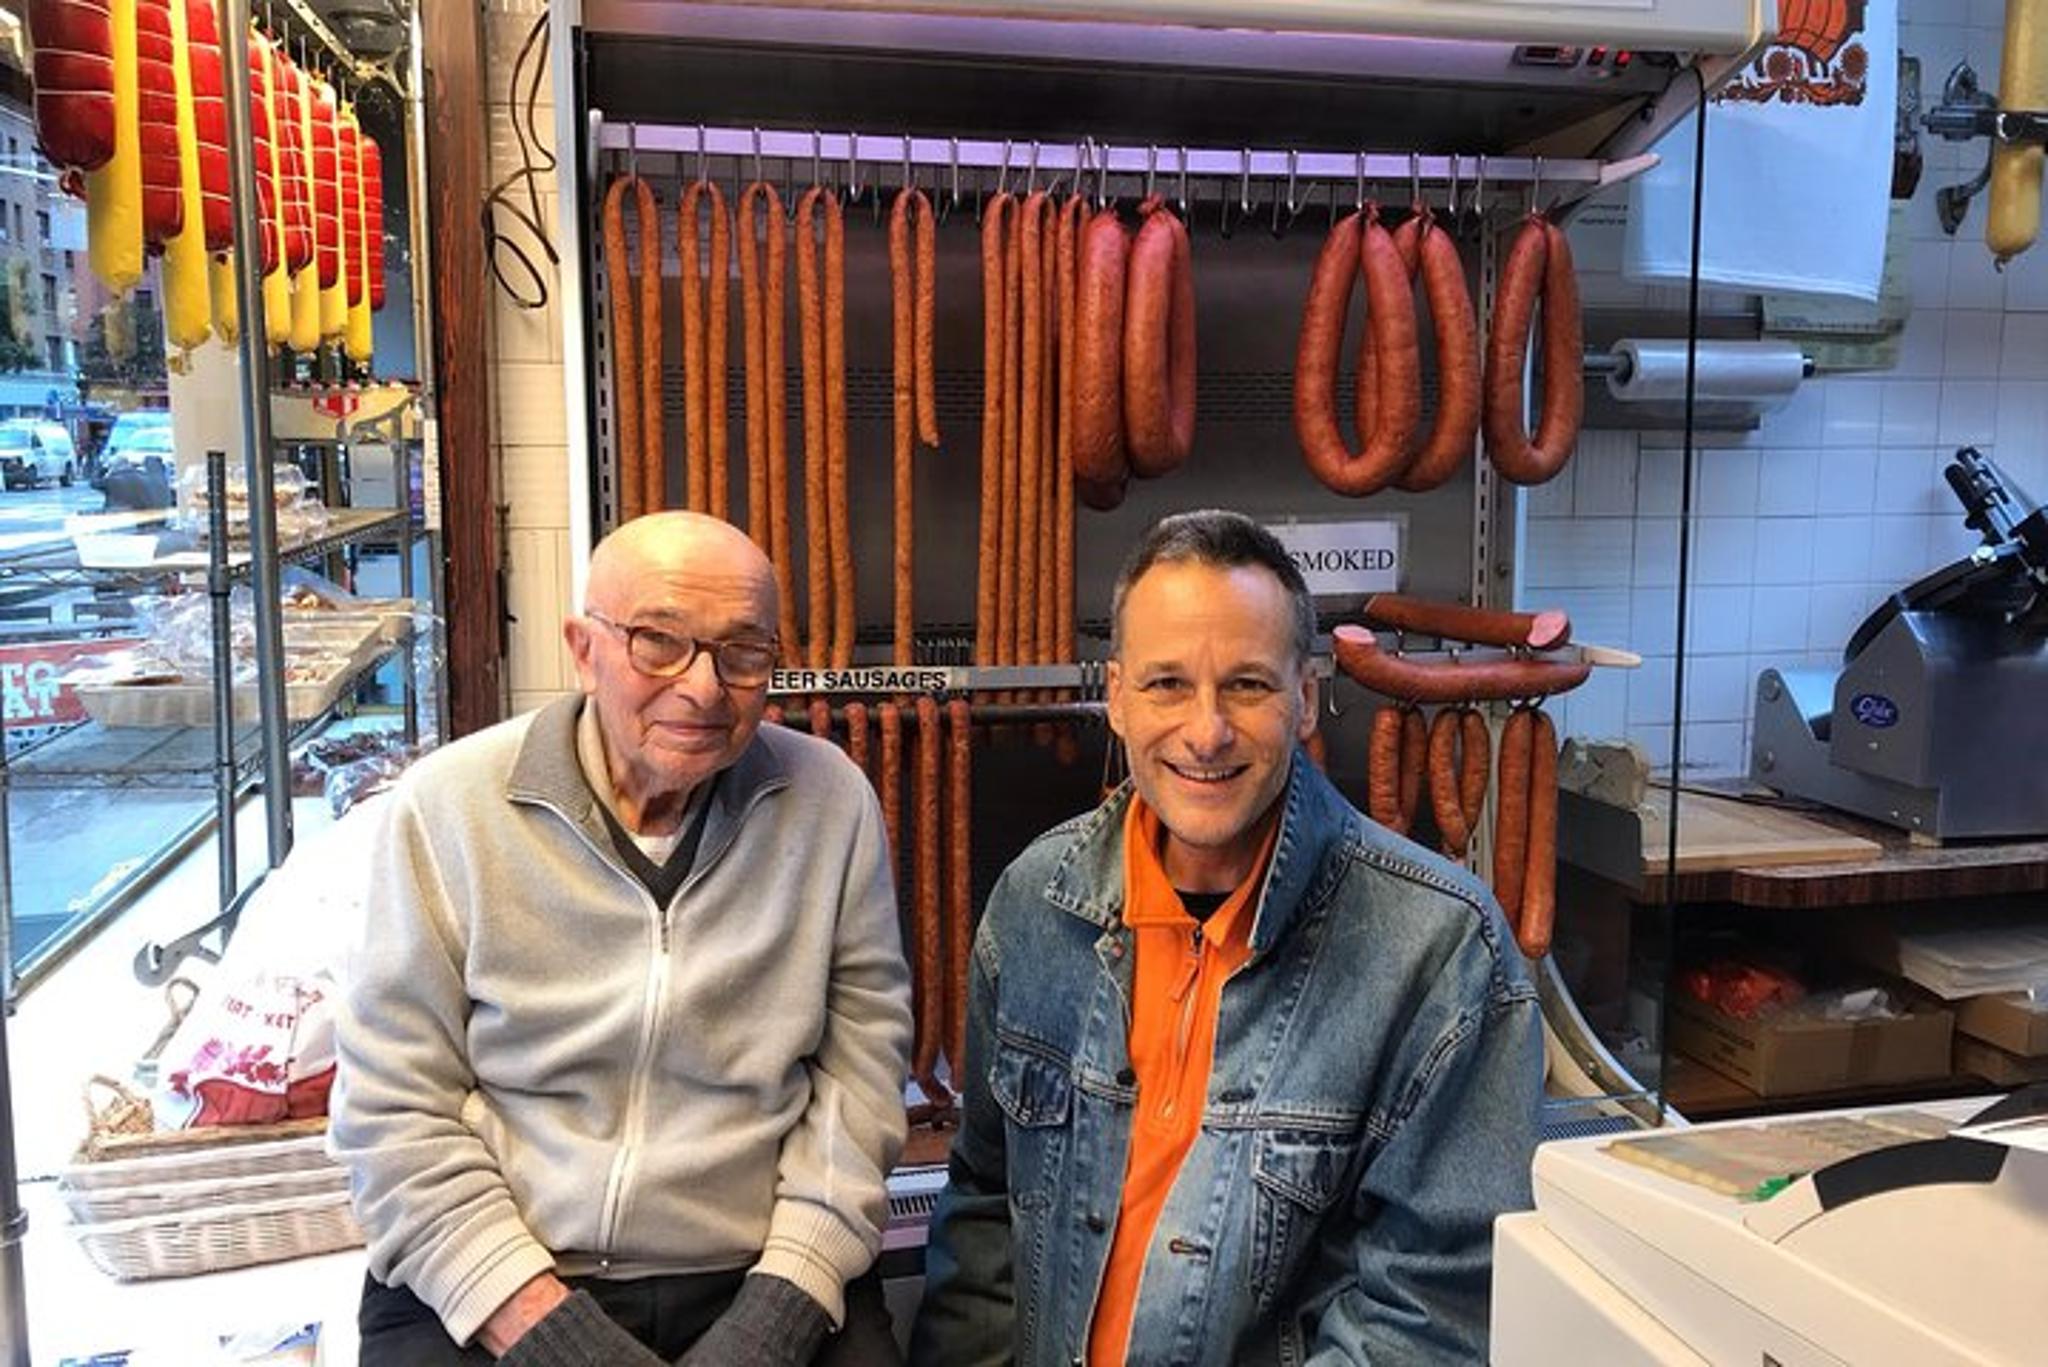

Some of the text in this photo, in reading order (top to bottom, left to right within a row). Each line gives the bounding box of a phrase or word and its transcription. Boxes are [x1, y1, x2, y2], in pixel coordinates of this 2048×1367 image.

[1289, 548, 1395, 572] SMOKED
[771, 671, 947, 690] EER SAUSAGES
